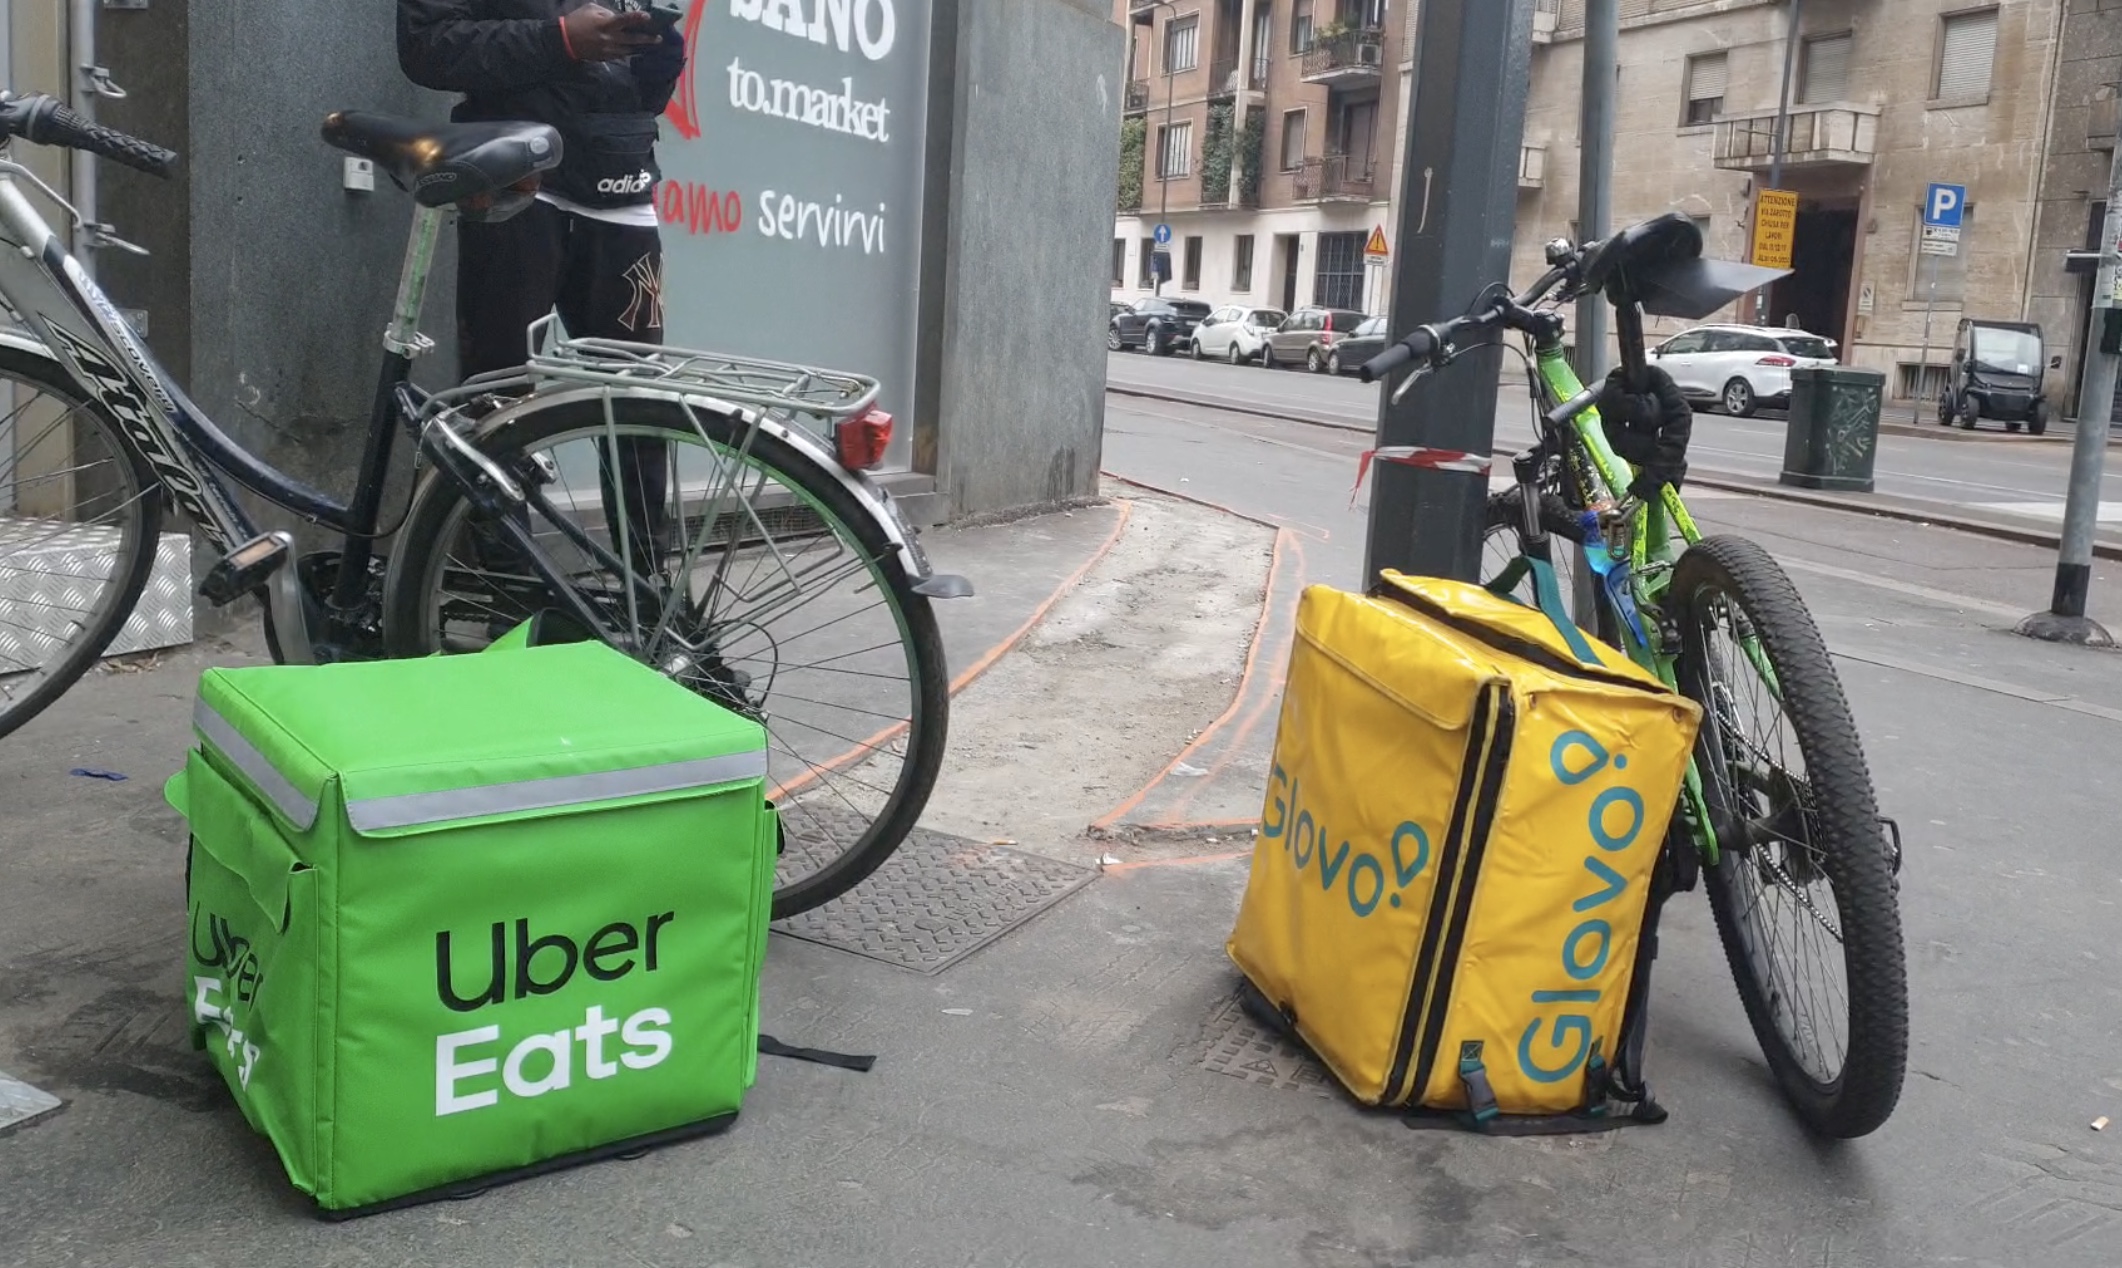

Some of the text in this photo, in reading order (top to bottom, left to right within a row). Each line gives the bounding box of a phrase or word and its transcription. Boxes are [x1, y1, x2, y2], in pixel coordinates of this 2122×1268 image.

[730, 0, 896, 60] NO
[726, 56, 891, 143] to.market
[758, 189, 886, 254] servirvi
[1760, 194, 1796, 207] ATTENZIONE
[1932, 187, 1957, 220] P
[1263, 762, 1384, 918] Glovo
[435, 911, 675, 1013] Uber
[1518, 786, 1645, 1084] Glovo
[435, 1004, 673, 1117] Eats
